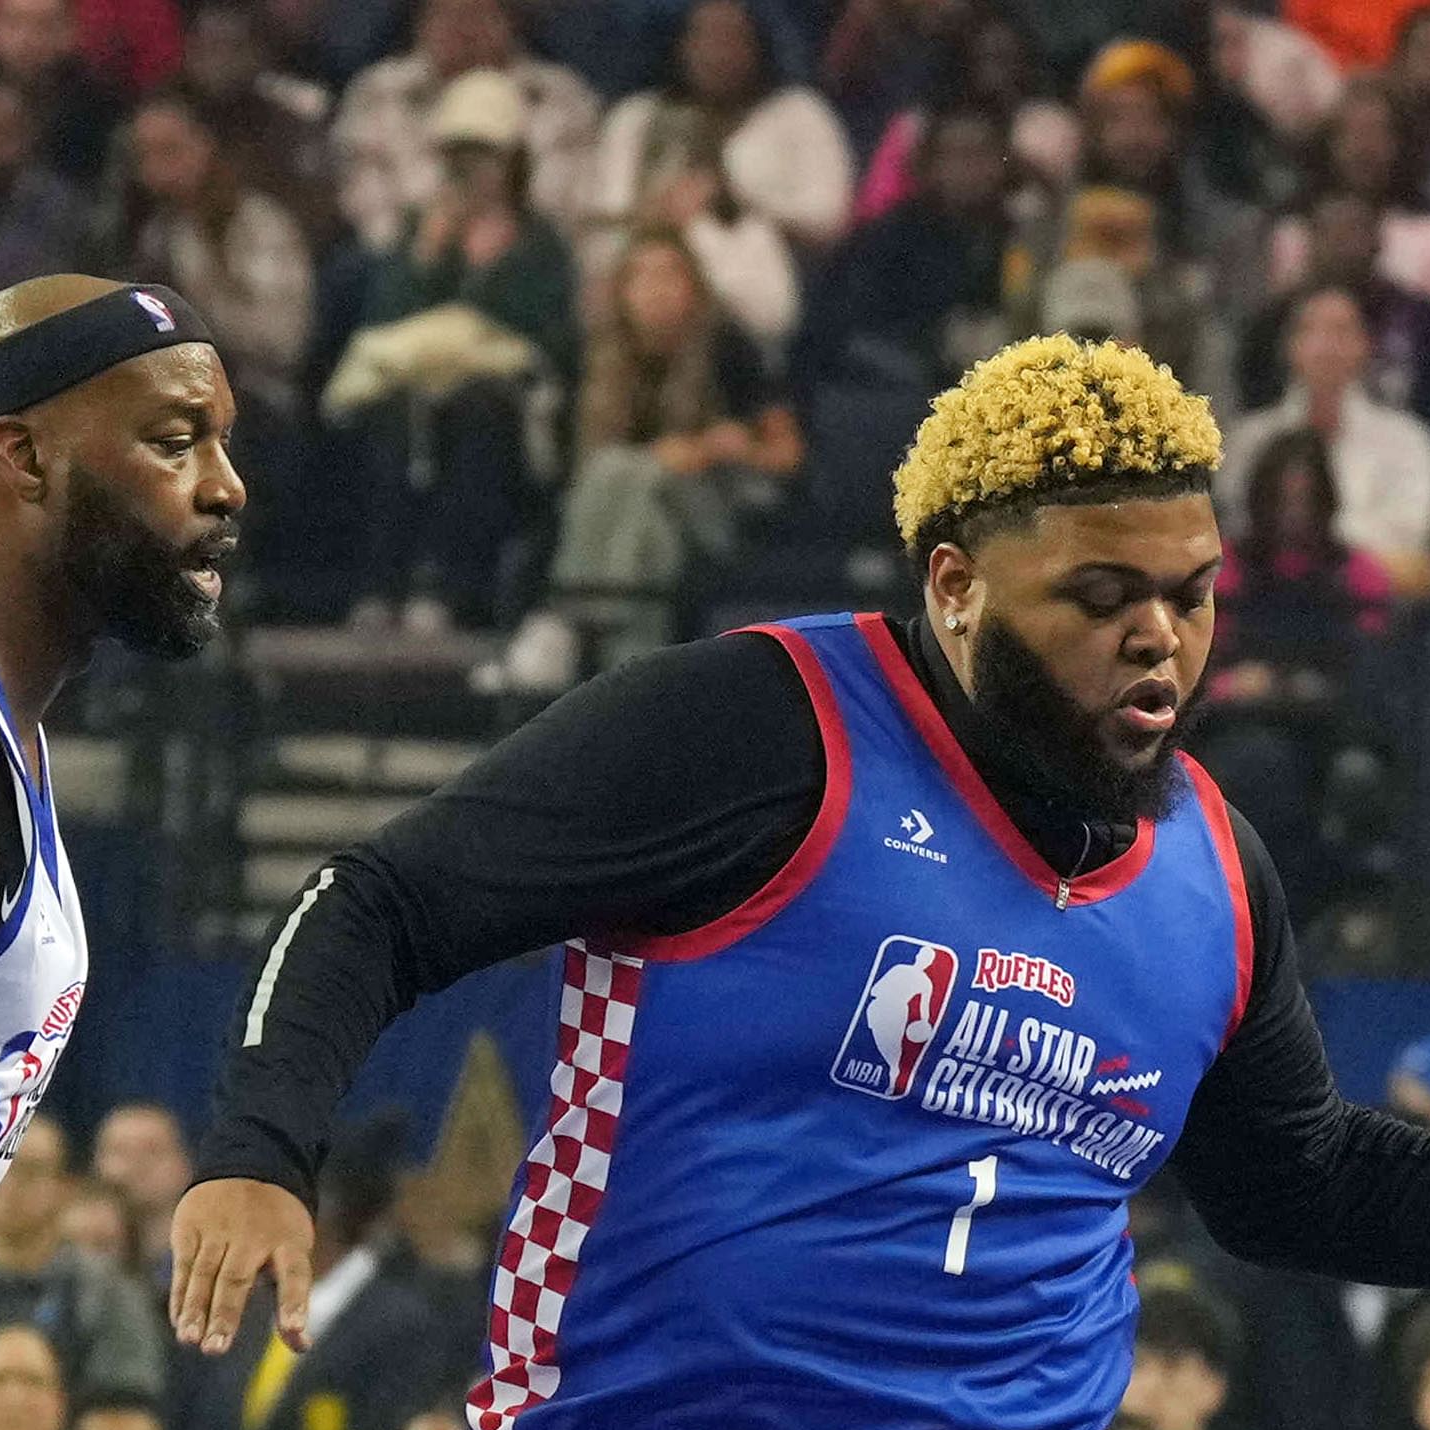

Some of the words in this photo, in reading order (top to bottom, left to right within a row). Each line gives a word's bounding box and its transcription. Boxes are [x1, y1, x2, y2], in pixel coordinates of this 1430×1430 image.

[883, 837, 948, 864] CONVERSE
[974, 951, 1075, 1005] RUFFLES
[842, 1059, 883, 1086] NBA
[942, 999, 1010, 1066] ALL
[1006, 1016, 1097, 1095] STAR
[921, 1057, 1094, 1146] CELEBRITY
[1070, 1112, 1165, 1179] GAME
[943, 1154, 999, 1276] 1
